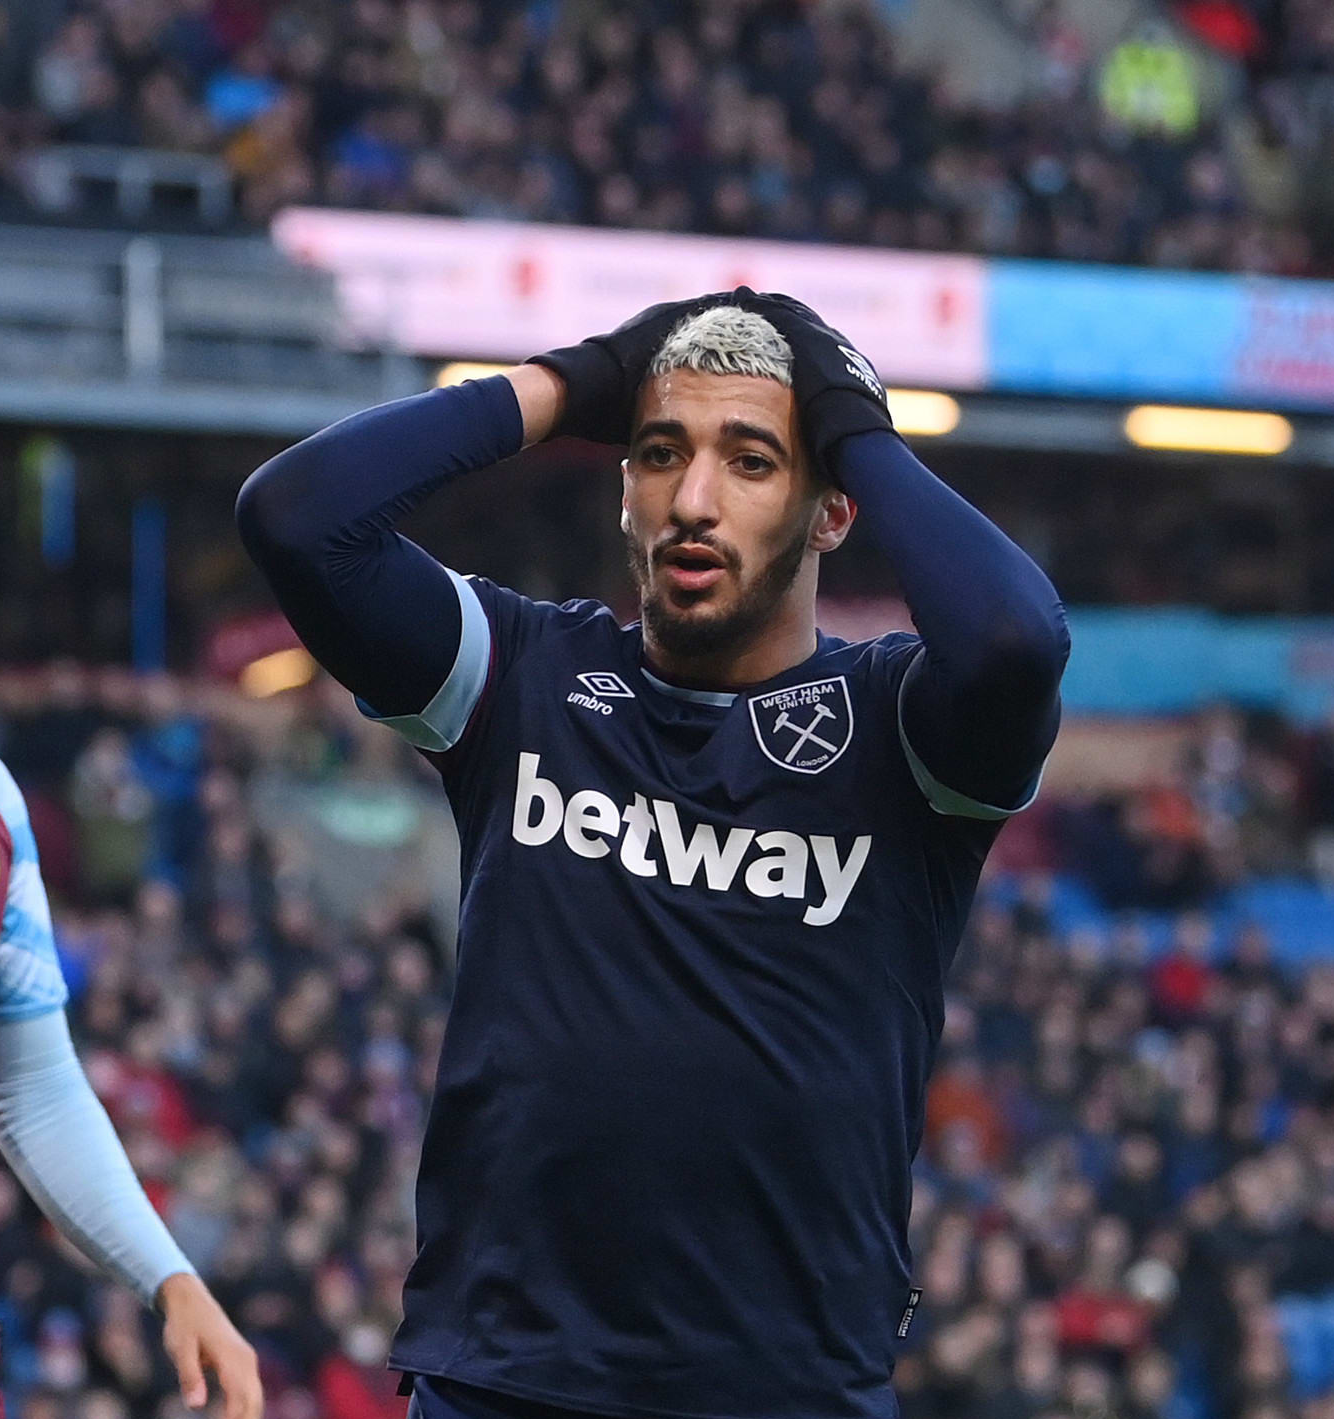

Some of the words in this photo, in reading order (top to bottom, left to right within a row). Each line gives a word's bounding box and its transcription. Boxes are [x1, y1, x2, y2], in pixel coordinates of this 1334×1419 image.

[567, 692, 613, 715] umbro
[761, 691, 798, 708] WEST
[801, 684, 835, 697] HAM
[778, 695, 821, 710] UNITED
[796, 754, 829, 767] LONDON
[512, 752, 872, 927] betway
